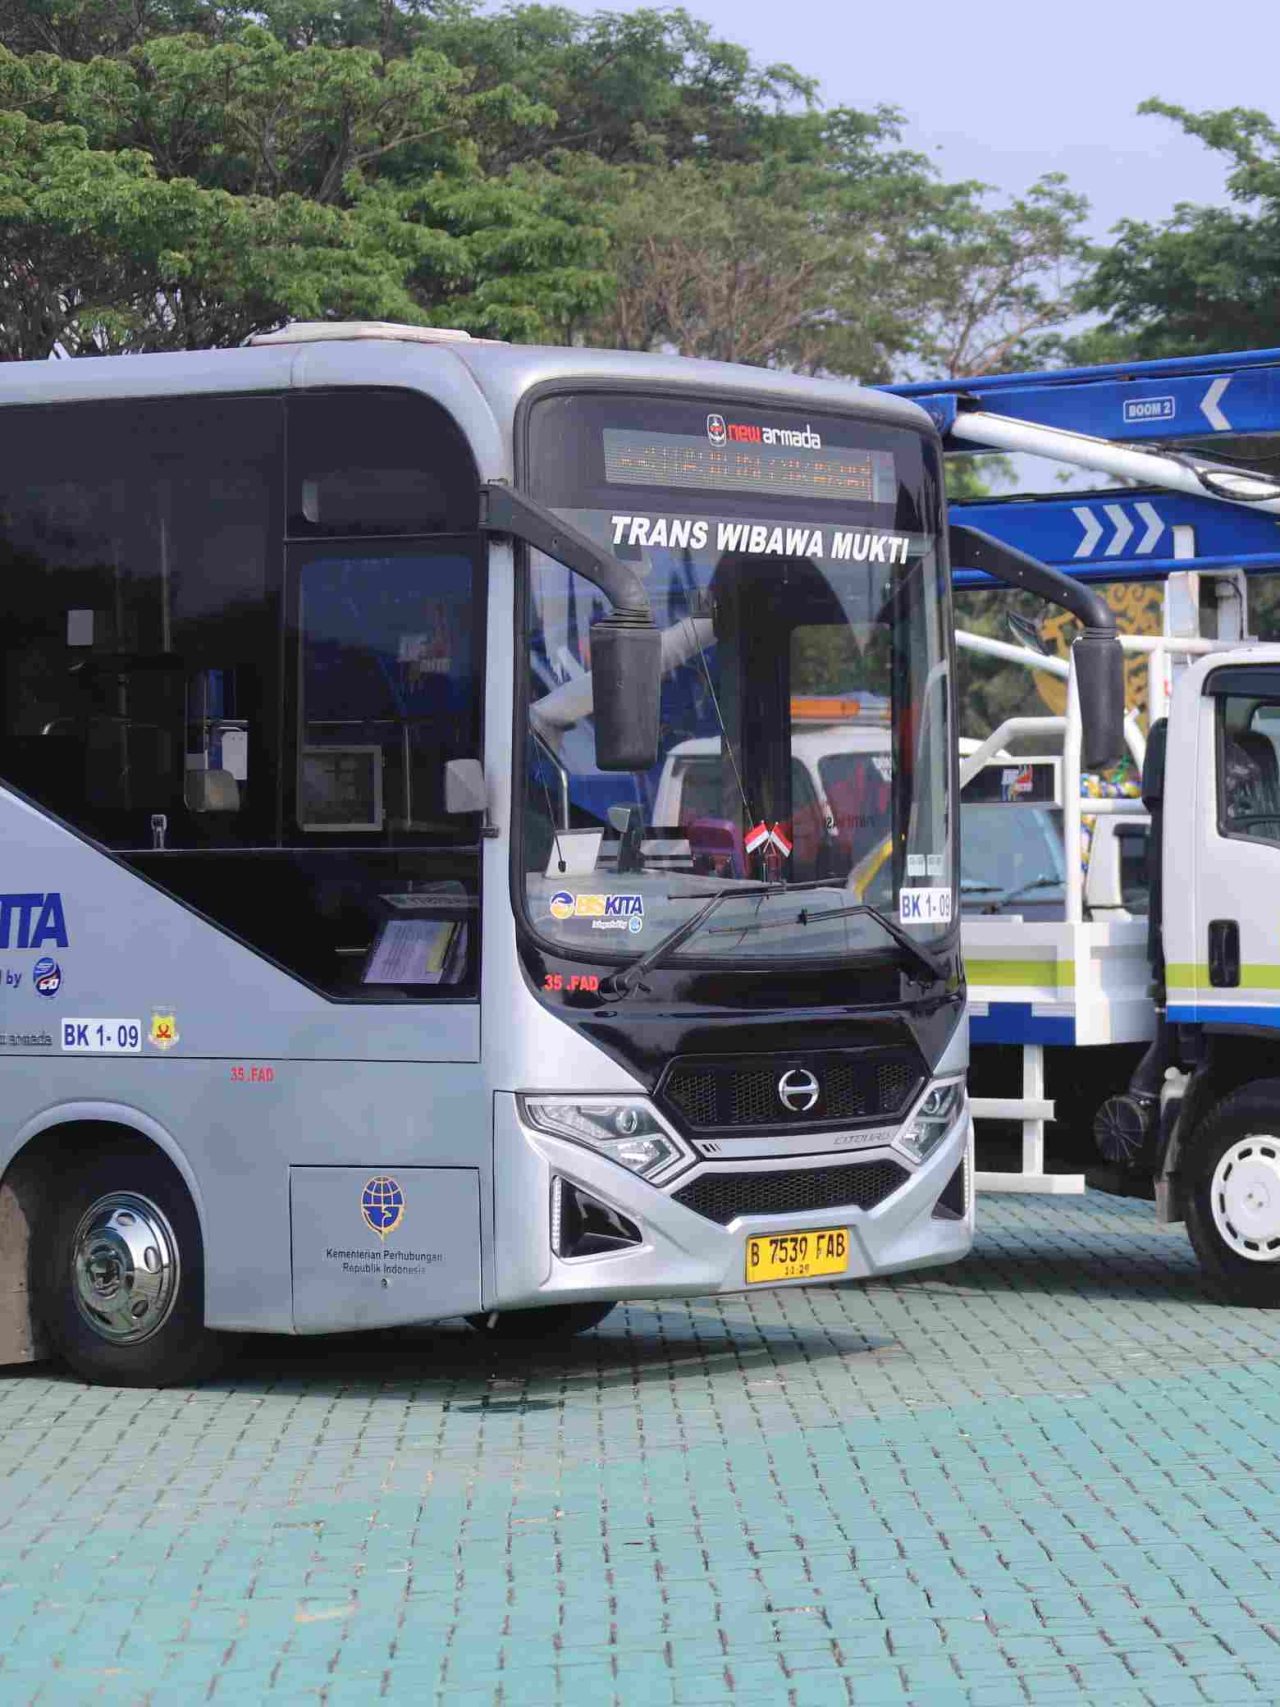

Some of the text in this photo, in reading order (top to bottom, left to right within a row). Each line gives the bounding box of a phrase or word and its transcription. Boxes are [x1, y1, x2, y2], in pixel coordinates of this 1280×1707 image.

[1129, 401, 1171, 417] BOOM 2
[727, 424, 821, 449] new armada
[611, 516, 910, 565] TRANS WIBAWA MUKTI
[901, 895, 921, 917] BK
[940, 894, 950, 916] 09
[6, 969, 21, 988] by
[544, 974, 562, 991] 35
[64, 1024, 89, 1046] BK
[117, 1025, 138, 1048] 09
[326, 1248, 443, 1263] Kementerian Perhubungan
[751, 1233, 845, 1267] B 7539 FAB
[342, 1262, 380, 1273] Republik
